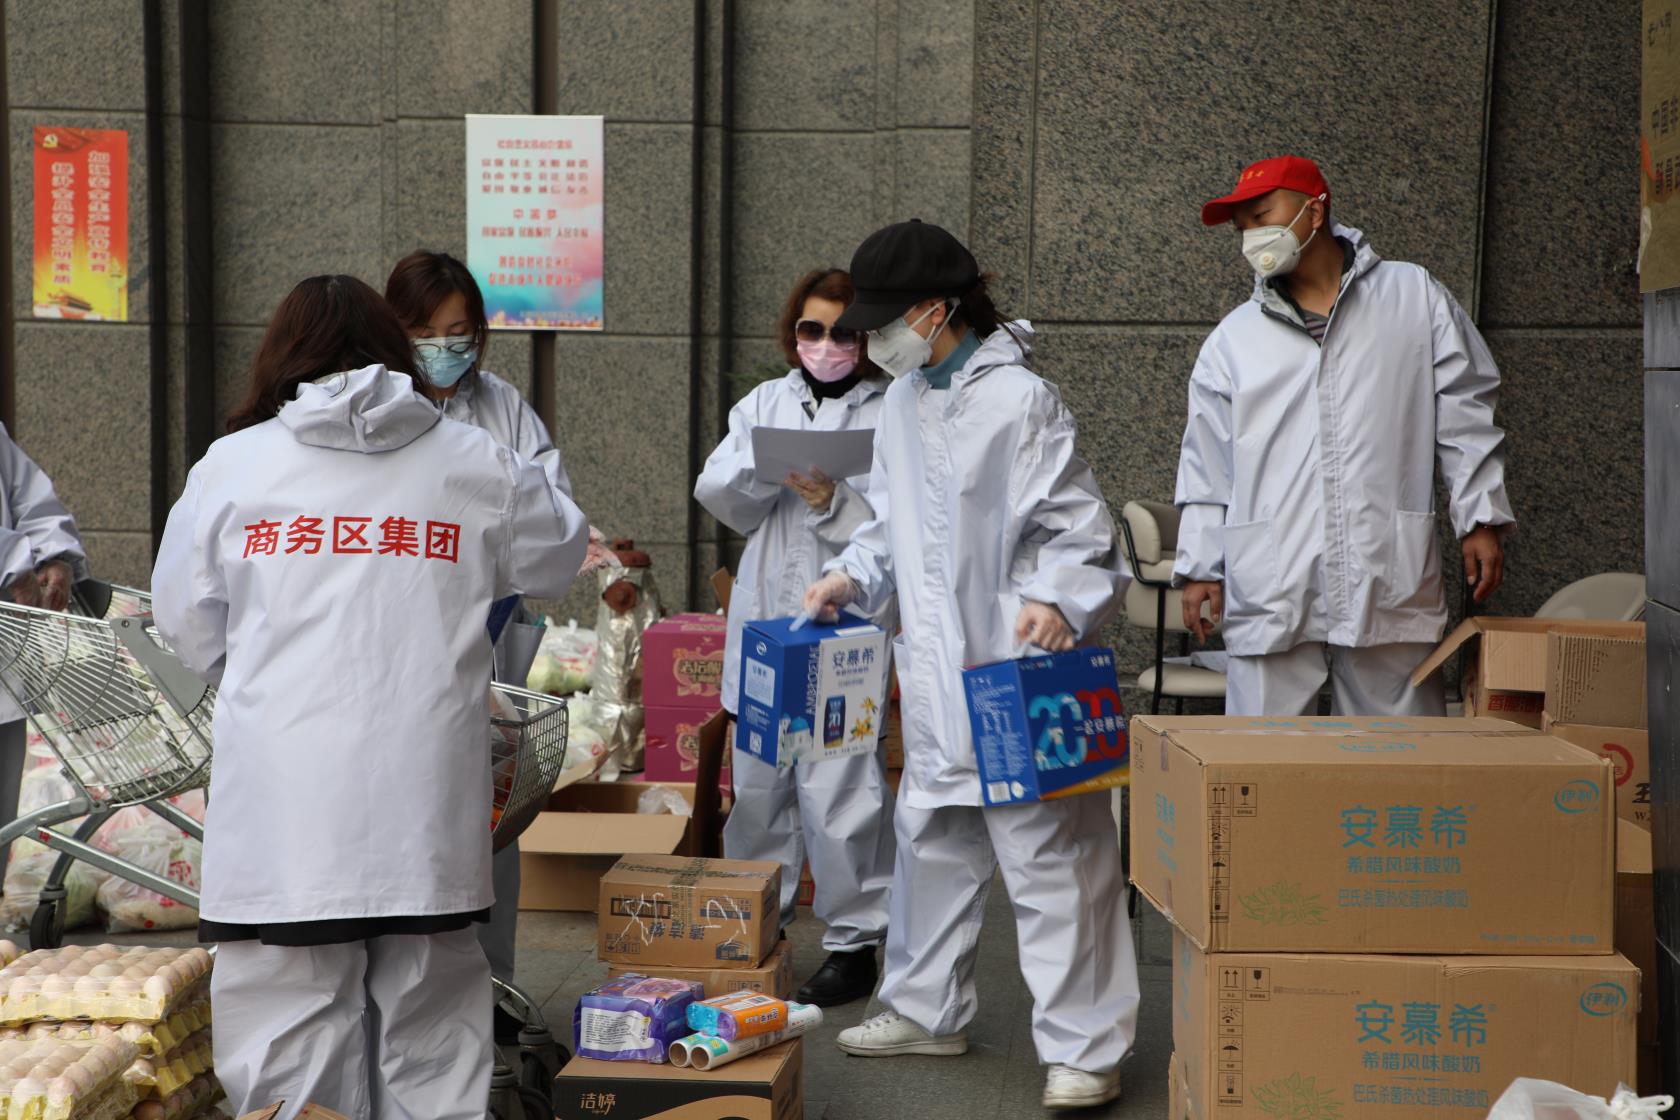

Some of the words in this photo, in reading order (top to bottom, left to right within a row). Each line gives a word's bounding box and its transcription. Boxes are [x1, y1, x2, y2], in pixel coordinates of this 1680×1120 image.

[243, 514, 461, 563] 商务区集团
[1562, 790, 1593, 803] 伊利
[1340, 805, 1471, 848] 安慕希
[1346, 855, 1461, 874] 希腊风味酸奶
[1337, 889, 1469, 908] 巴氏杀菌热处理风味酸奶
[1586, 992, 1620, 1007] 伊利
[1355, 1000, 1489, 1047] 安慕希
[1362, 1052, 1481, 1073] 希腊风味酸奶
[579, 1092, 617, 1116] 洁婷
[1353, 1084, 1489, 1107] 巴氏杀菌热处理风味酸奶
